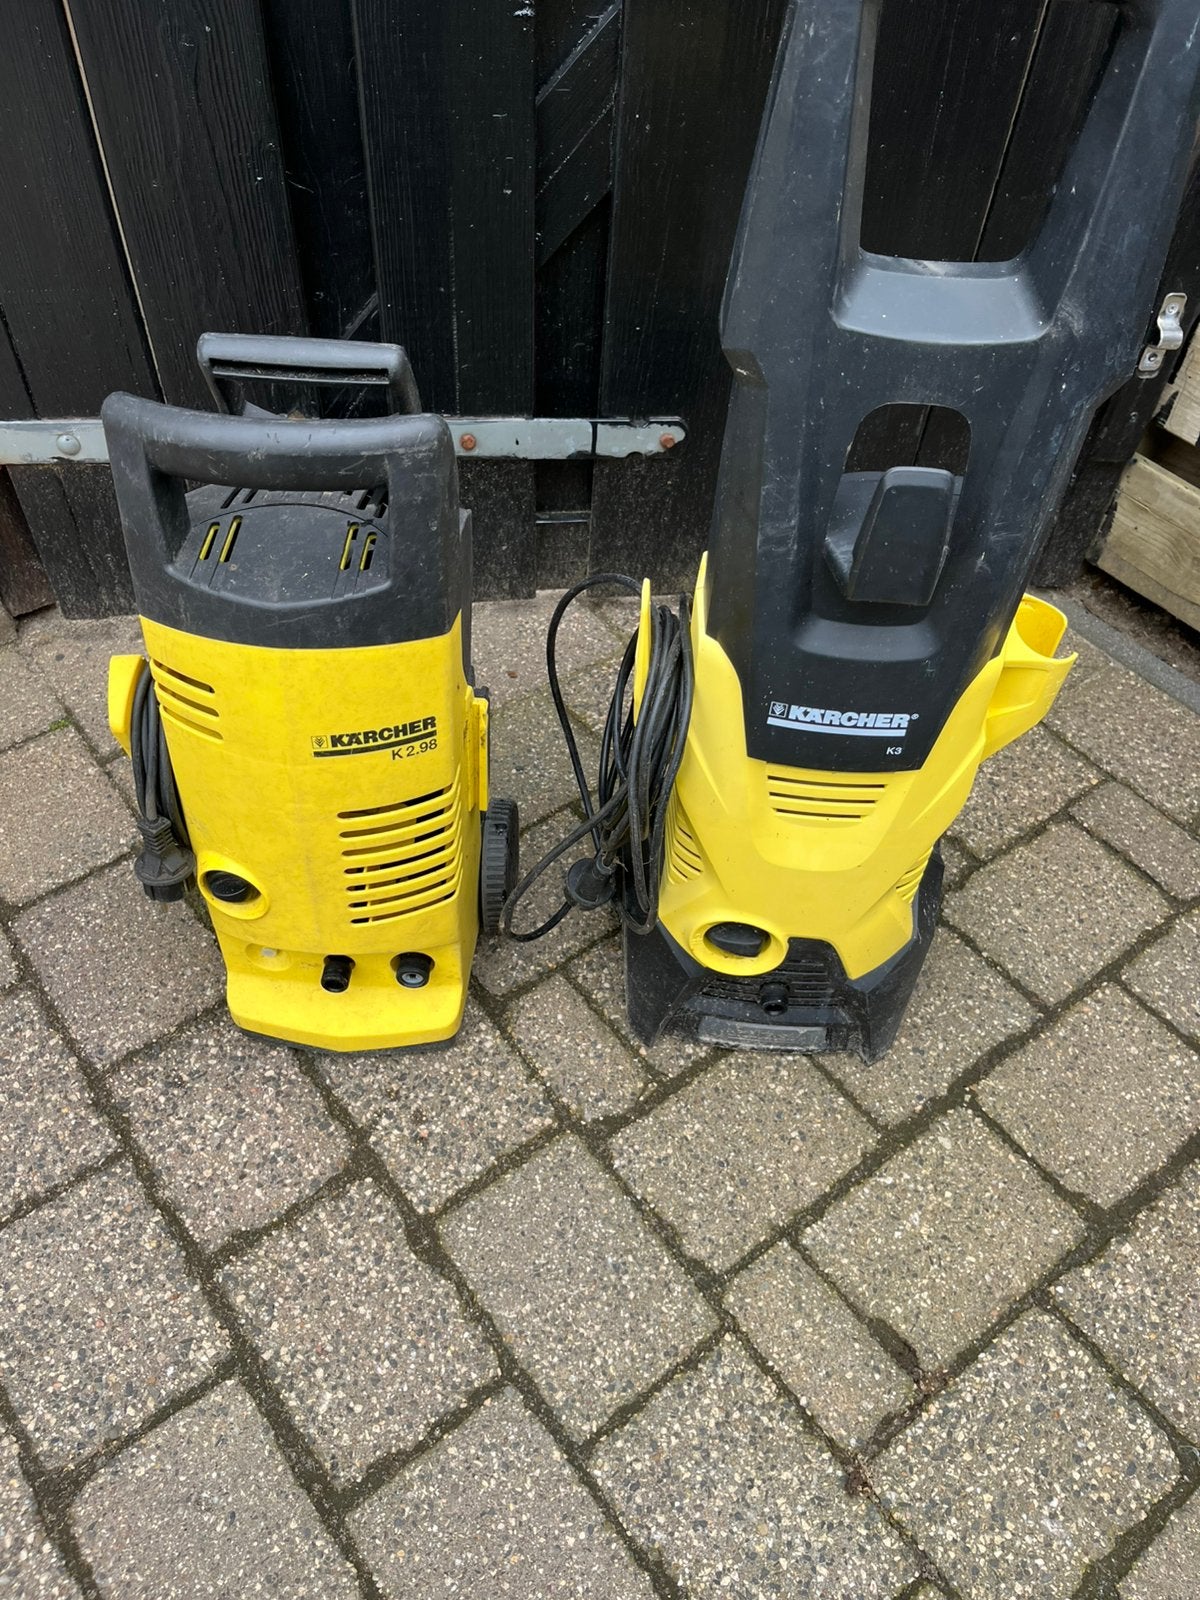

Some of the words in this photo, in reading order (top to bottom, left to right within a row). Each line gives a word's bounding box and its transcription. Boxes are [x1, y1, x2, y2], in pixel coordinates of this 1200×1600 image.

[391, 747, 404, 761] K
[406, 738, 438, 757] 2.98
[886, 746, 903, 755] K3
